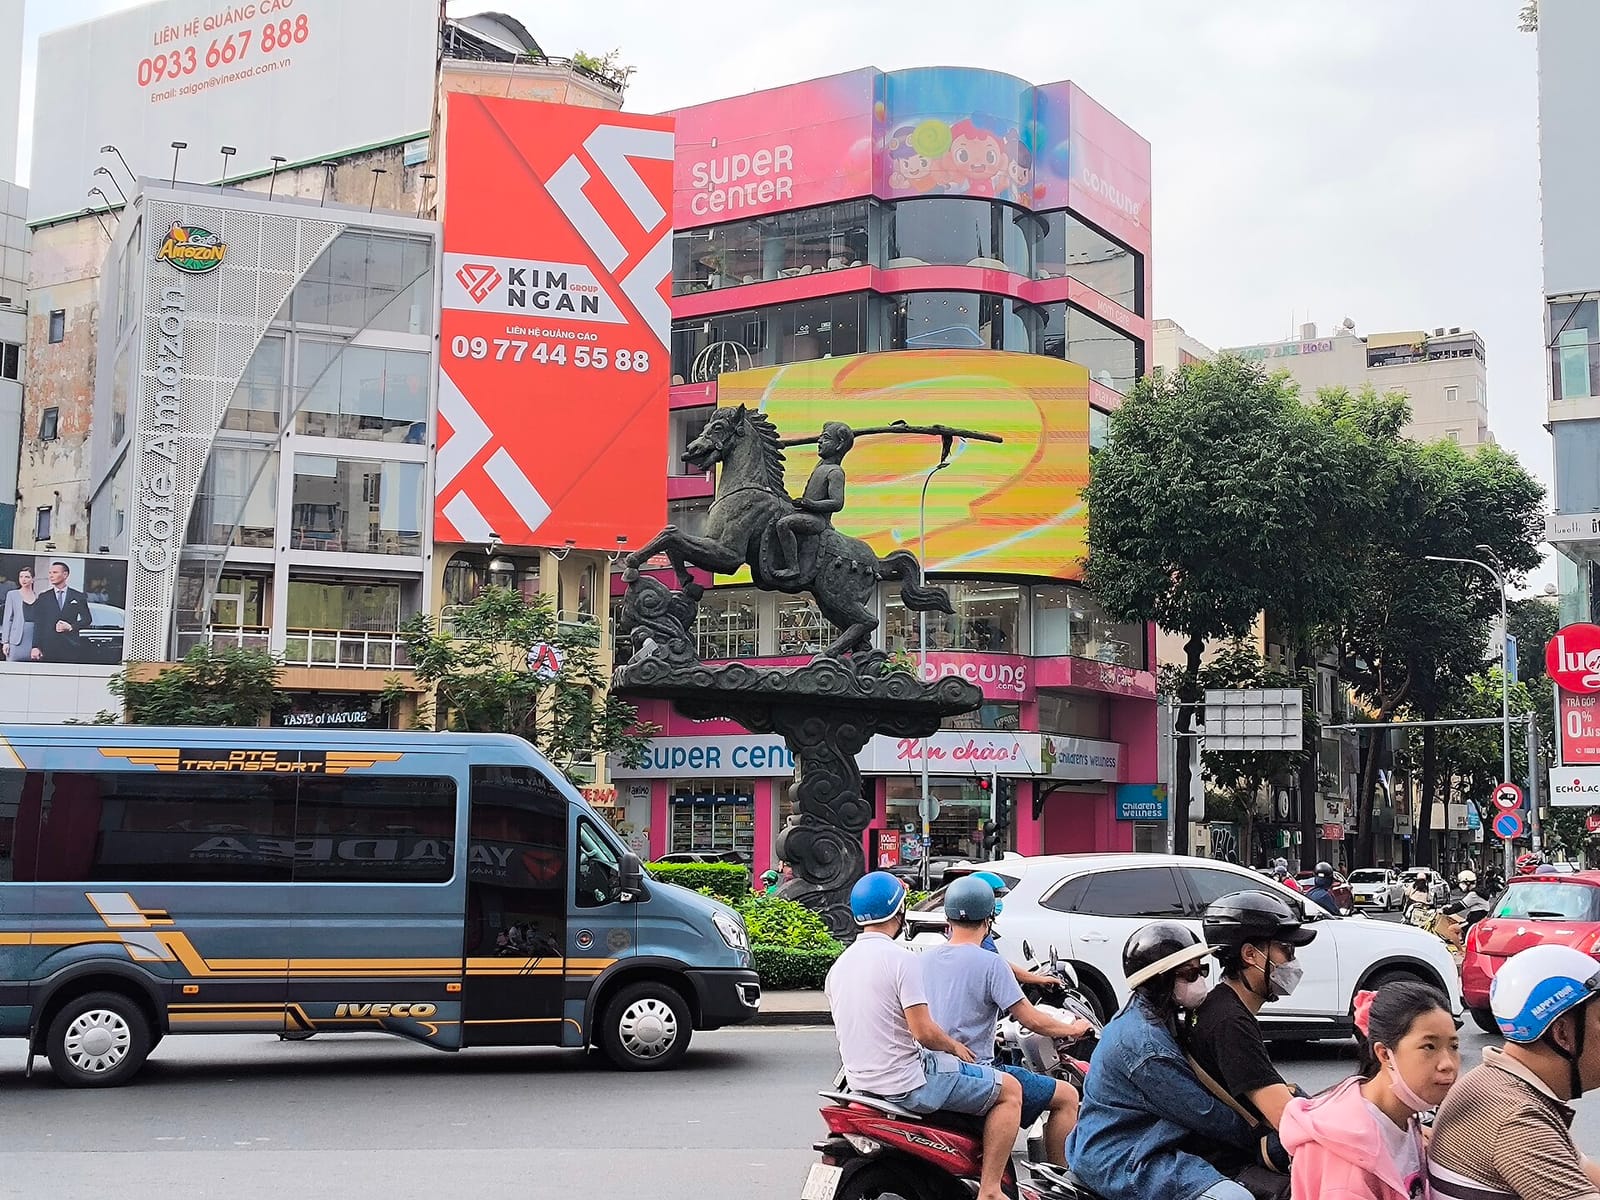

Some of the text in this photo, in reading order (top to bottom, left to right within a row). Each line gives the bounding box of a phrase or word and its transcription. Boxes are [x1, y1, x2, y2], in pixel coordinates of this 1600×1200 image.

[153, 25, 180, 46] LIÊN
[183, 17, 200, 38] HỆ
[203, 5, 256, 31] QUẢNG
[137, 14, 309, 87] 0933 667 888
[151, 57, 291, 103] Email: saigon@vinexad.com.vn
[508, 267, 568, 290] KIM
[569, 283, 599, 293] GROUP
[508, 288, 599, 314] NGAN
[506, 326, 598, 341] LIÊN HỆ QUẢNG CÁO
[451, 335, 650, 373] 09 77 44 55 88
[1302, 339, 1334, 355] Hotel
[145, 283, 186, 465] Amazon
[917, 662, 1027, 692] oncung
[1566, 697, 1596, 707] TRẢ GÓP
[283, 714, 313, 726] TASTE
[327, 711, 367, 723] NATURE
[229, 750, 278, 761] DTC
[952, 739, 1020, 761] chào!
[182, 760, 323, 773] TRANSPORT
[1555, 785, 1599, 793] ECHOLAC
[333, 1002, 439, 1018] IVECO
